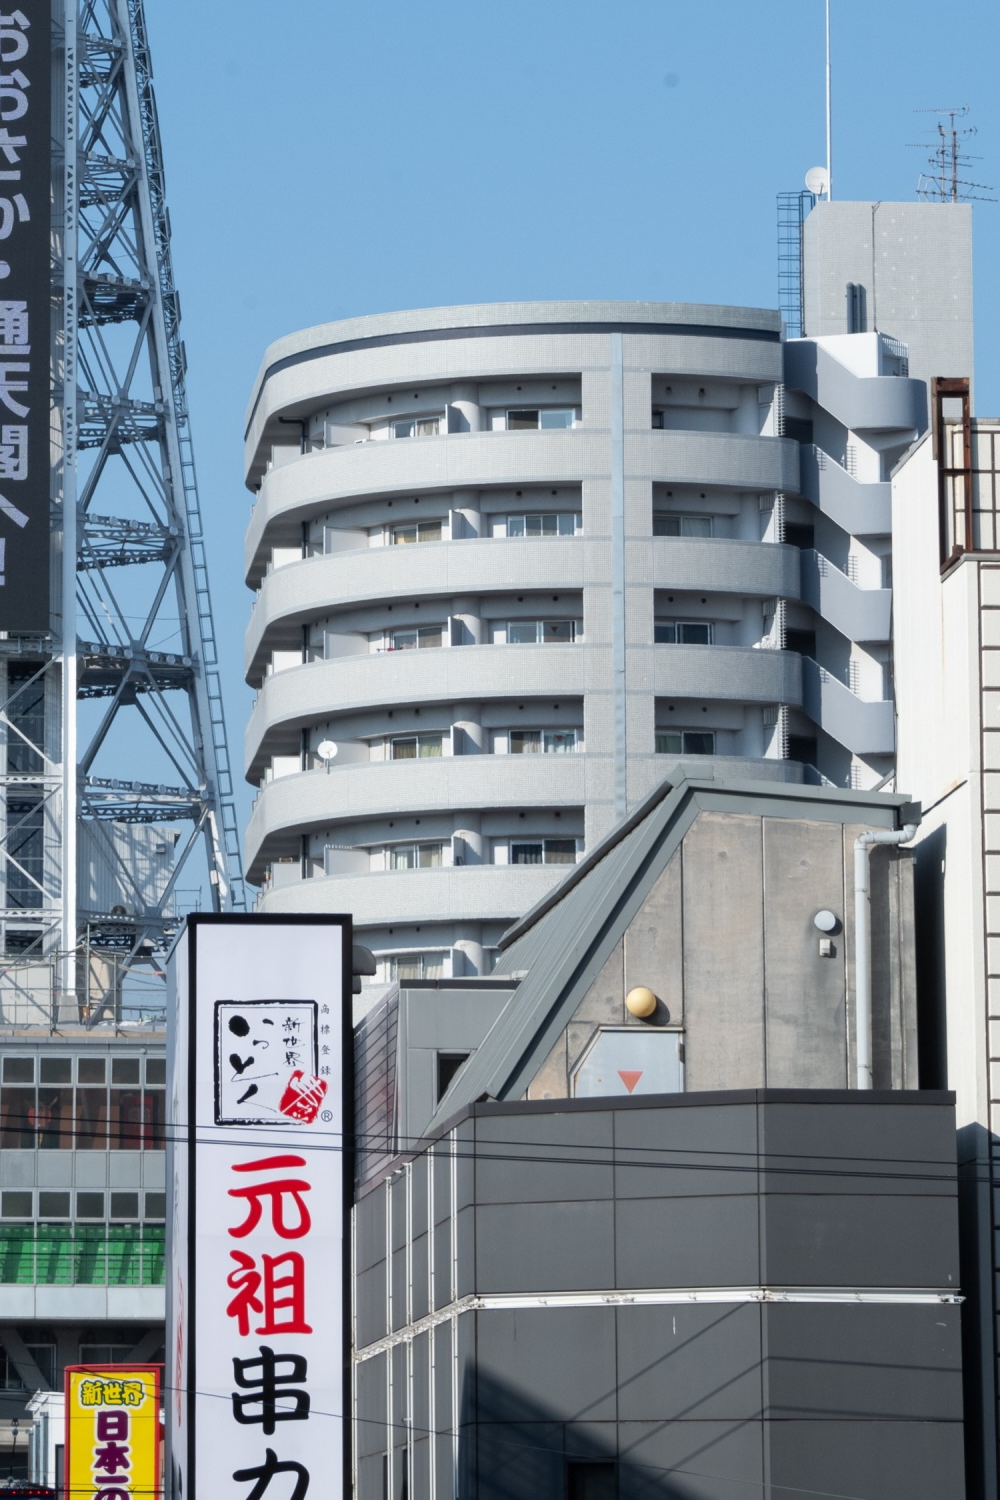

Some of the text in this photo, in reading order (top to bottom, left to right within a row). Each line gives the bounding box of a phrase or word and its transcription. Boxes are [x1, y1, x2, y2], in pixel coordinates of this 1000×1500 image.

[281, 1016, 305, 1067] 新世界
[81, 1380, 144, 1405] 新世界
